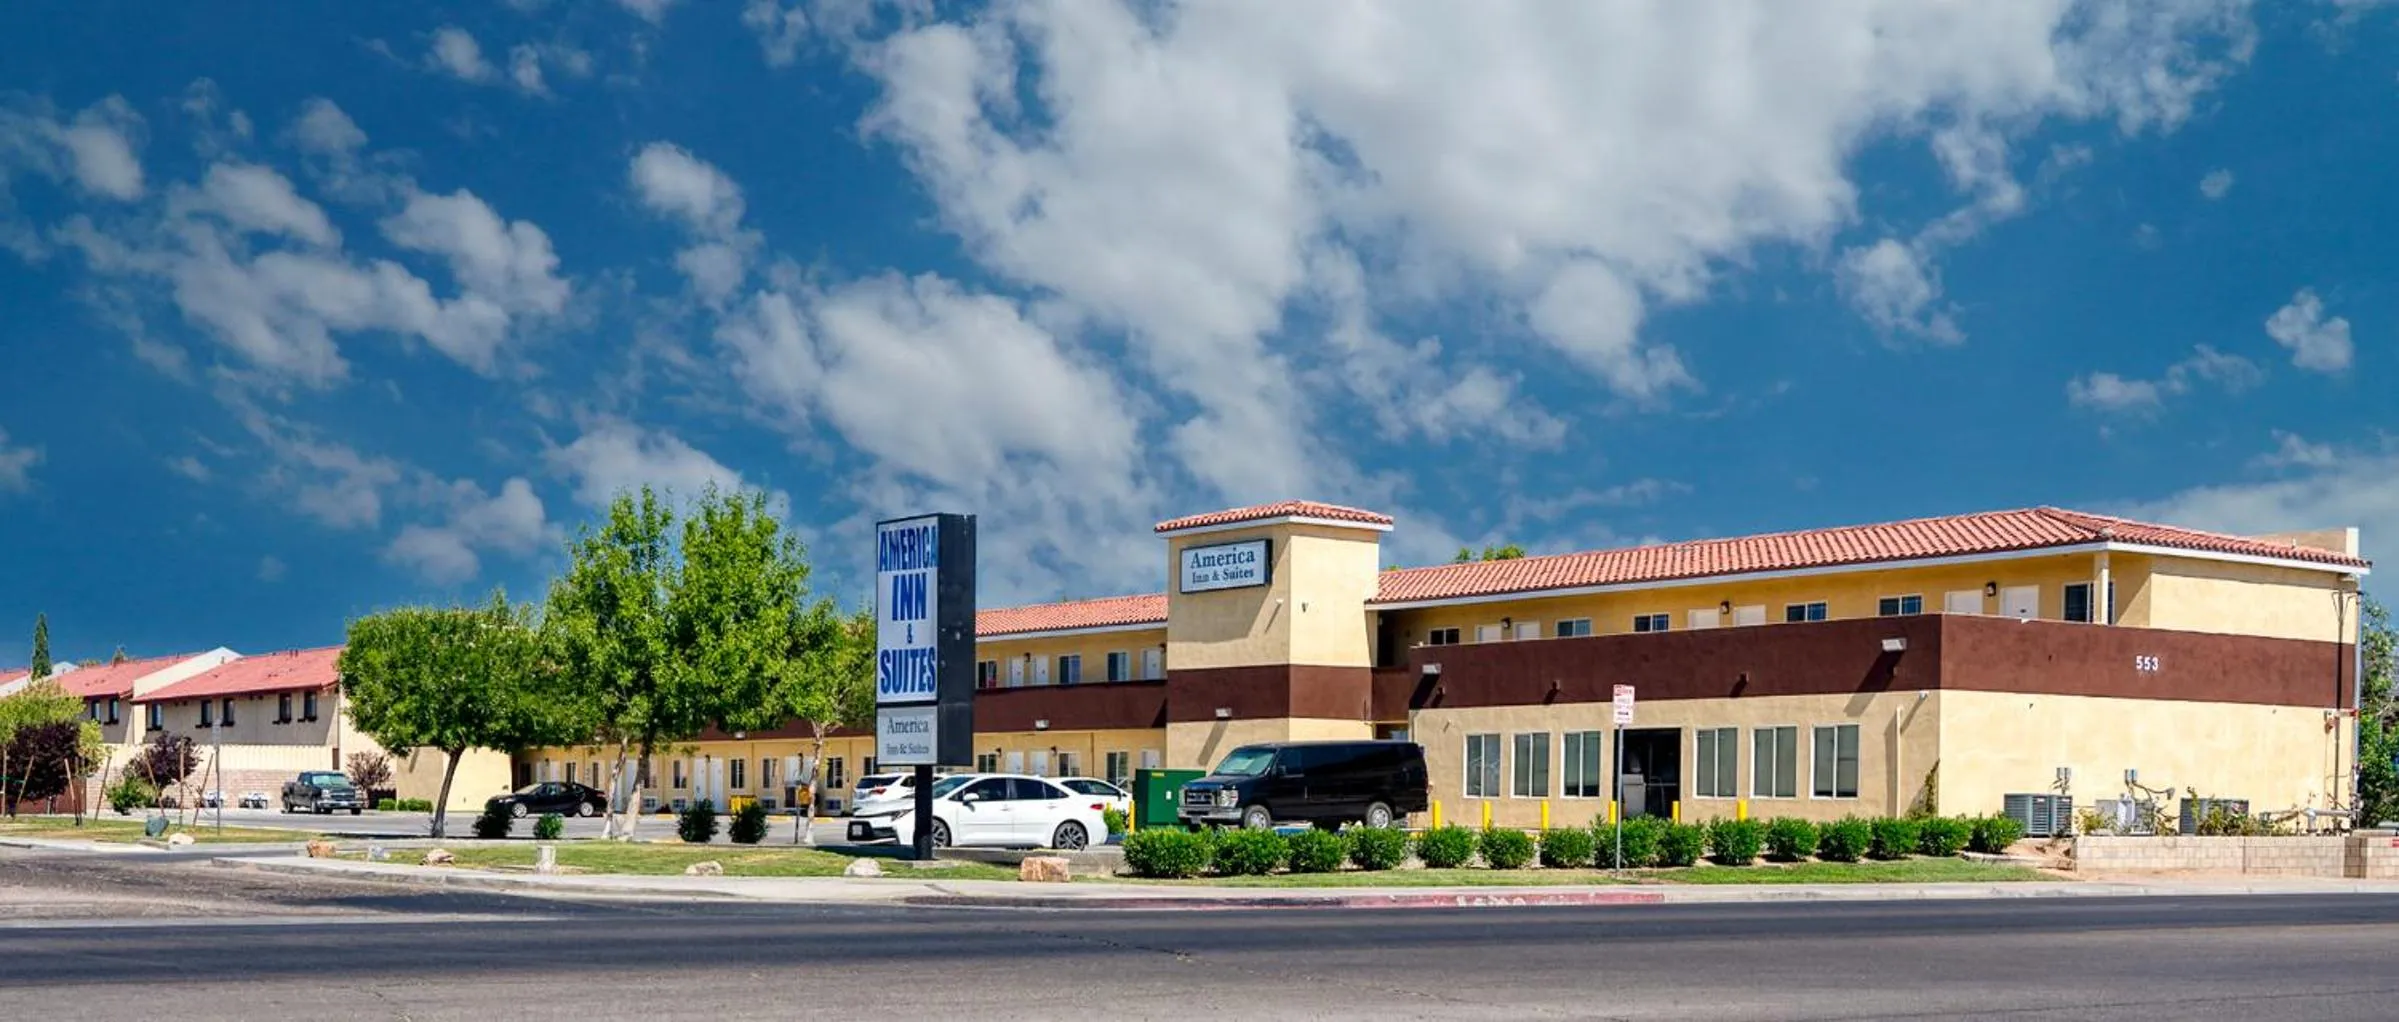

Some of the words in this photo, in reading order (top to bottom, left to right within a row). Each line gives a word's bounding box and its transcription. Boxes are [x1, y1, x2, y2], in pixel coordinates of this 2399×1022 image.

[879, 525, 938, 572] AMERICA
[1190, 547, 1255, 568] America
[1192, 570, 1209, 584] Inn
[1212, 570, 1220, 581] &
[1222, 566, 1254, 580] Suites
[892, 572, 926, 621] INN
[907, 623, 912, 643] &
[880, 646, 936, 694] SUITES
[2136, 655, 2159, 671] 553
[887, 716, 930, 734] America
